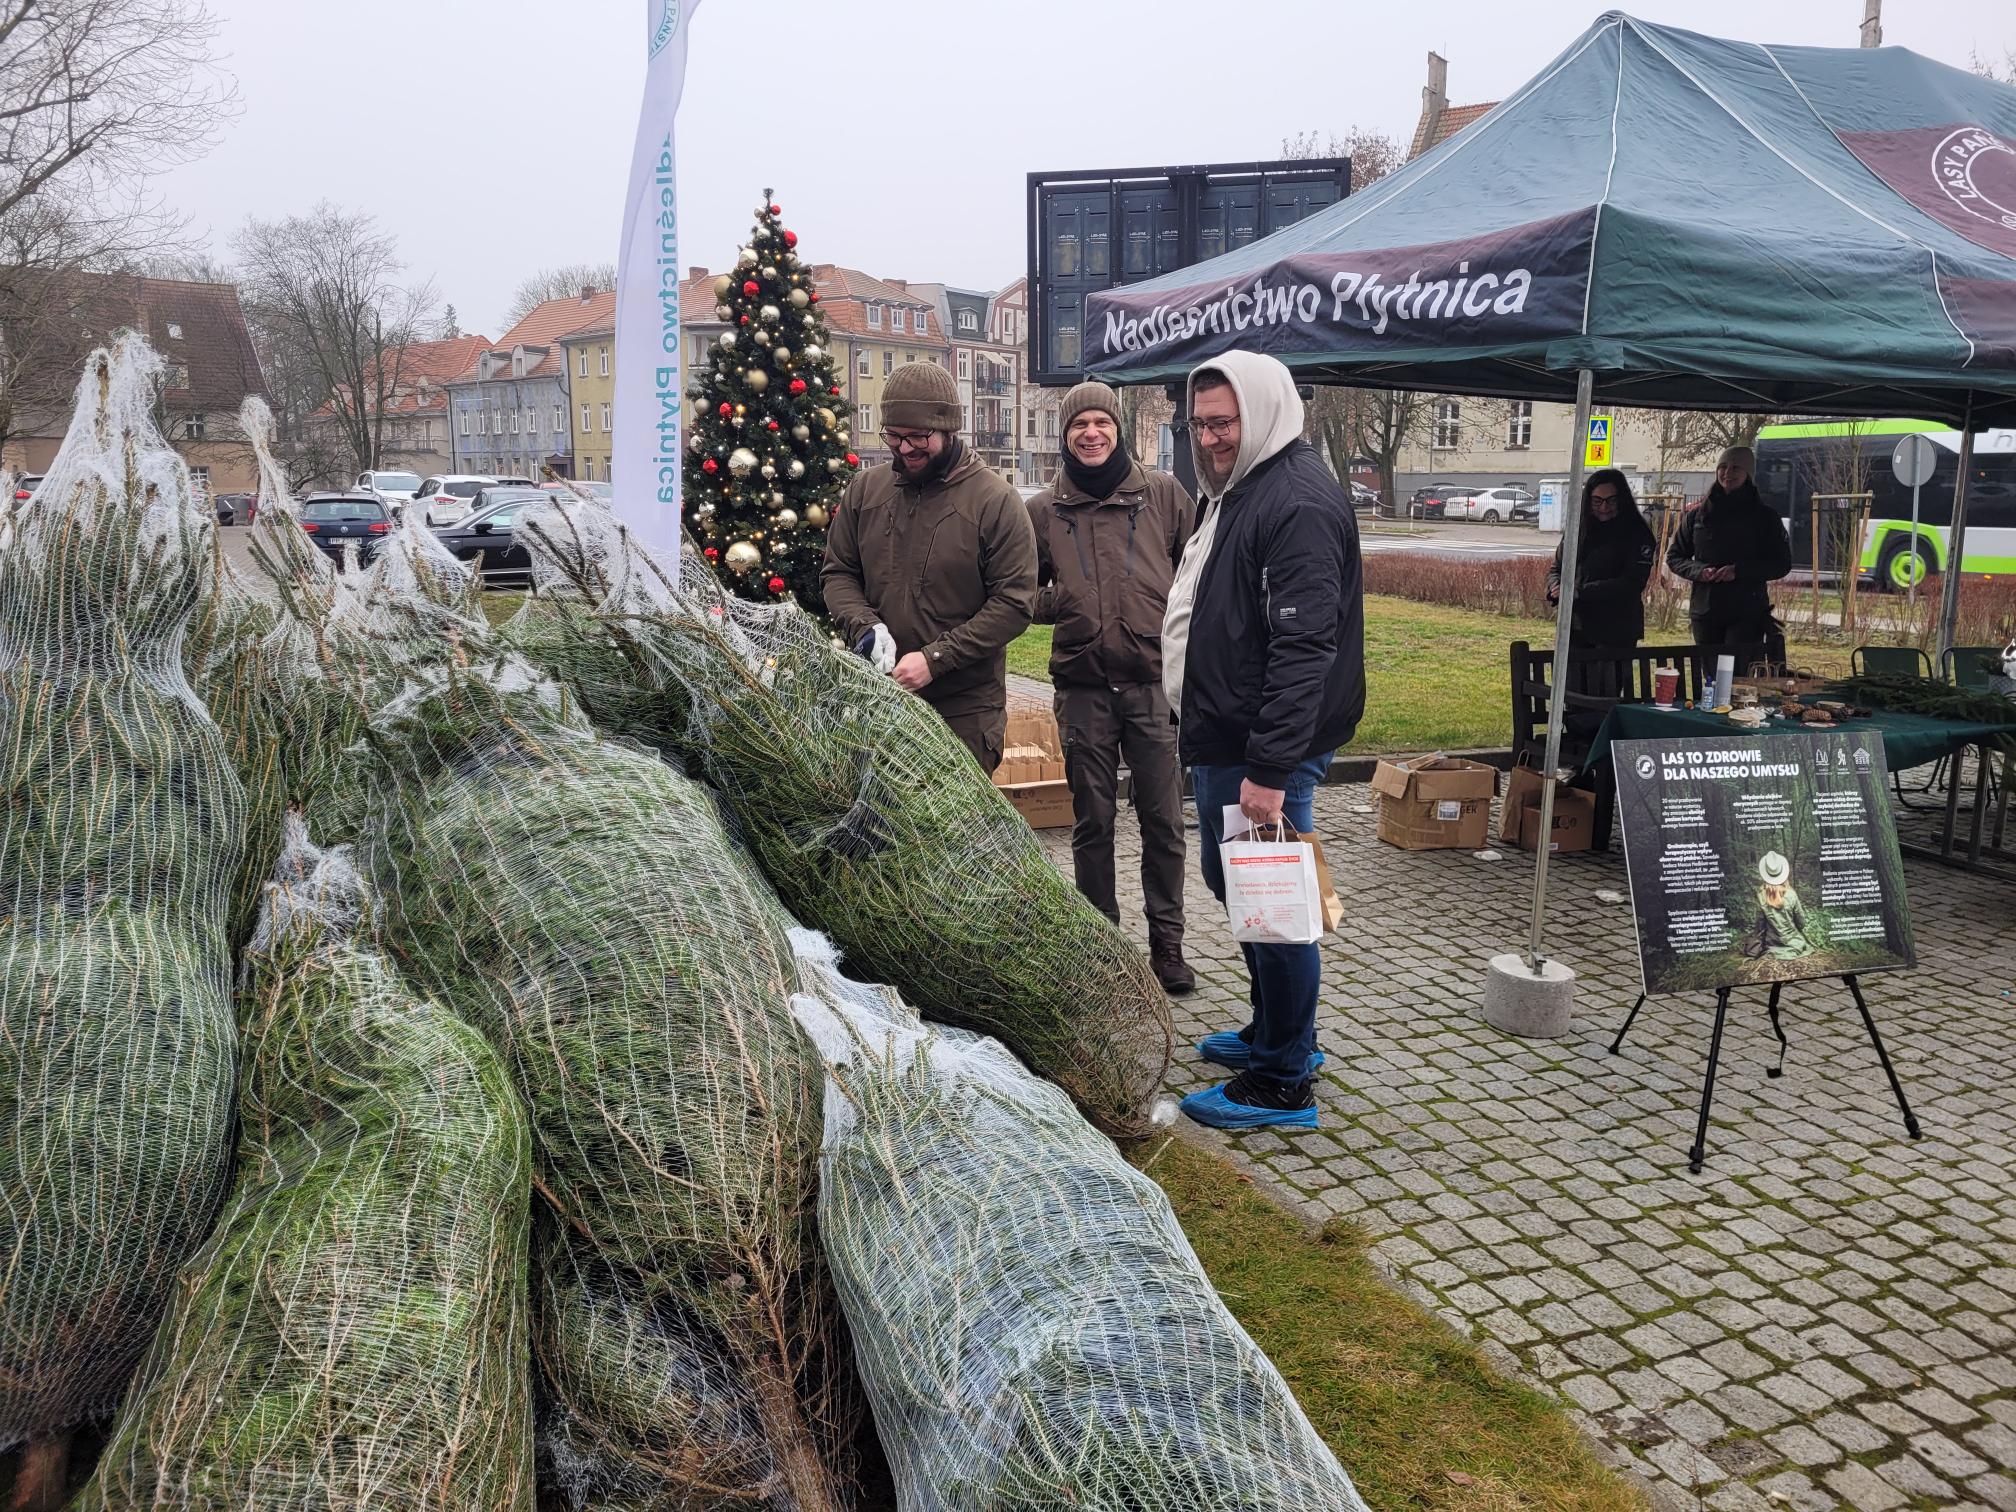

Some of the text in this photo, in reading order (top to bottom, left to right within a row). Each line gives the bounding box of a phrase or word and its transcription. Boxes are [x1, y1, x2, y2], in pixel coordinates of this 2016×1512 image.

[1331, 261, 1532, 335] Płytnica
[1661, 749, 1762, 765] LAS TO ZDROWIE
[1663, 767, 1689, 780] DLA
[1690, 765, 1749, 780] NASZEGO
[1751, 763, 1799, 777] UMYSŁU
